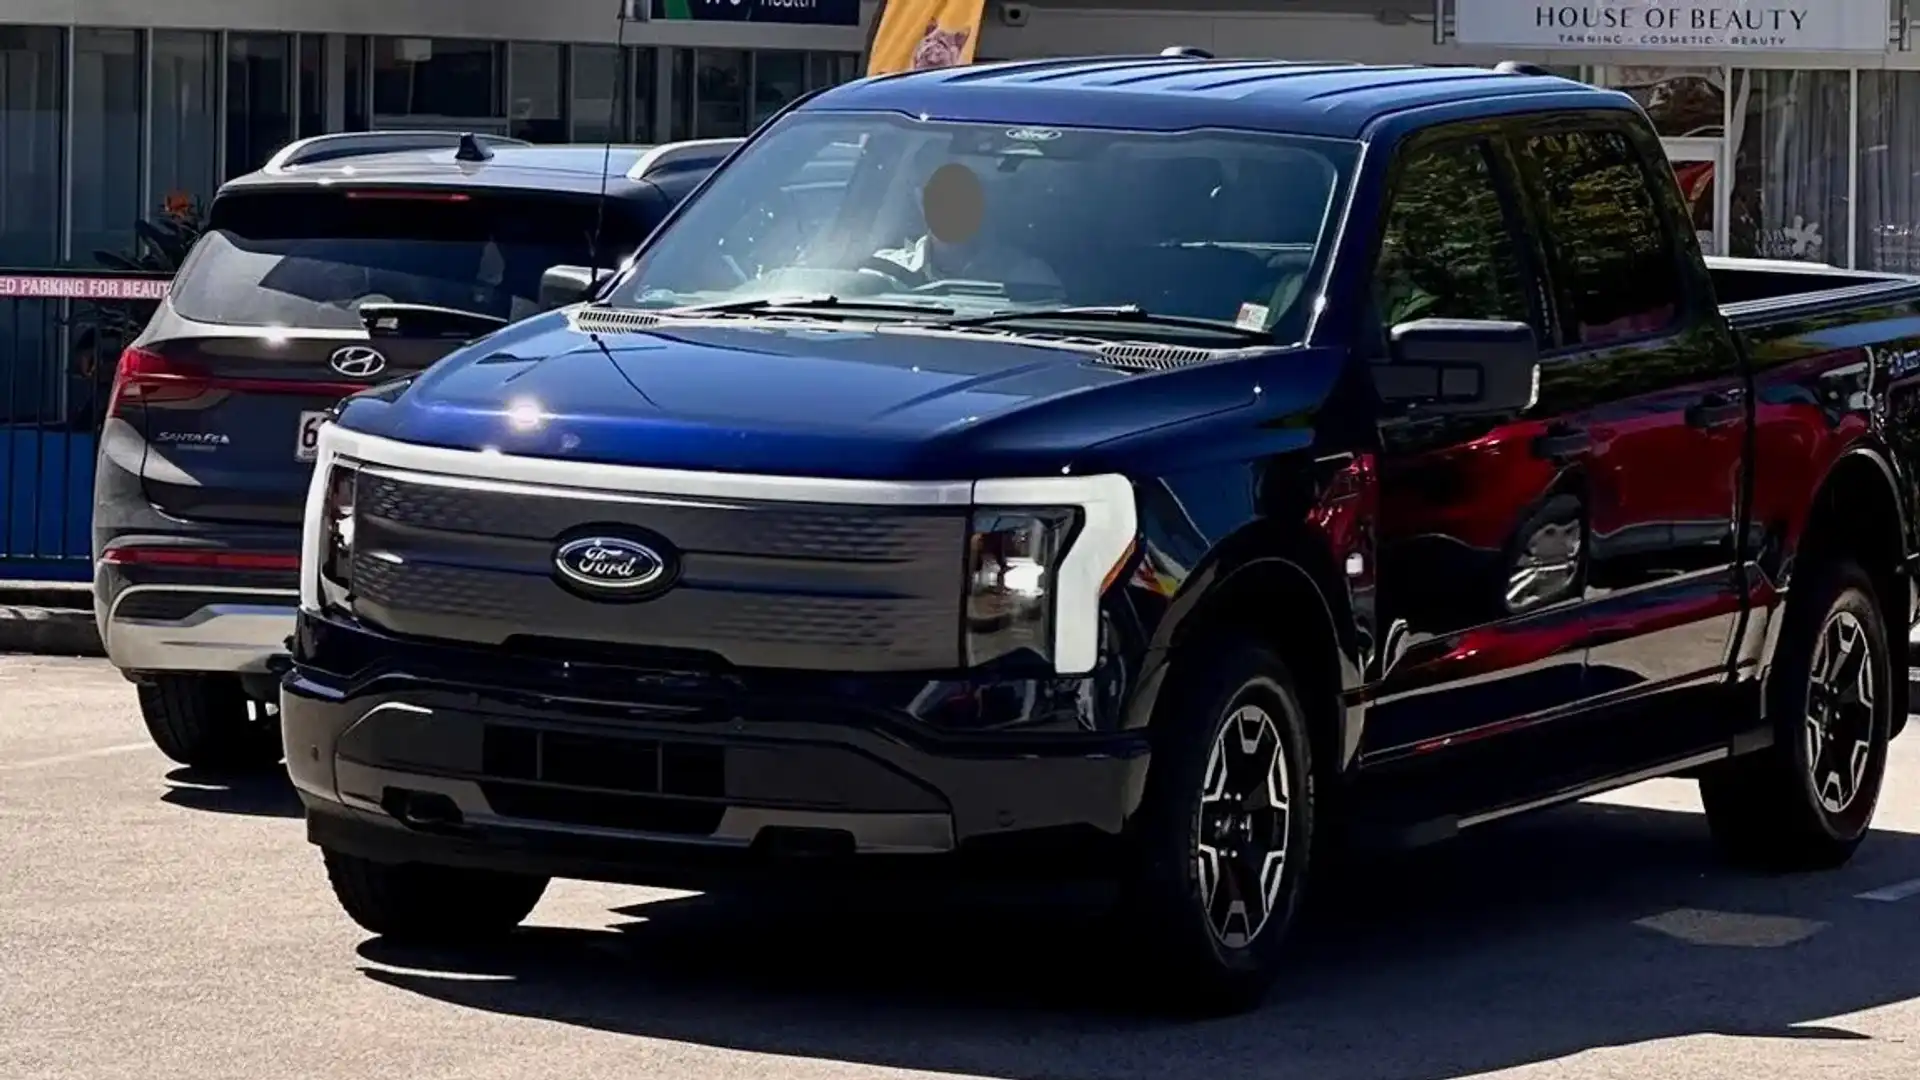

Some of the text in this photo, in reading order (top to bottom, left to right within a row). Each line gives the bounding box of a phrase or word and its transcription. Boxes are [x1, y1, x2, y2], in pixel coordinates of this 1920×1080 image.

[1536, 6, 1808, 30] HOUSE OF BEAUTY
[1558, 34, 1786, 46] TANNING COSMETIC BEAUTY
[20, 278, 84, 296] PARKING
[89, 280, 119, 298] FOR
[156, 431, 202, 442] SANTA
[579, 546, 637, 577] Ford
